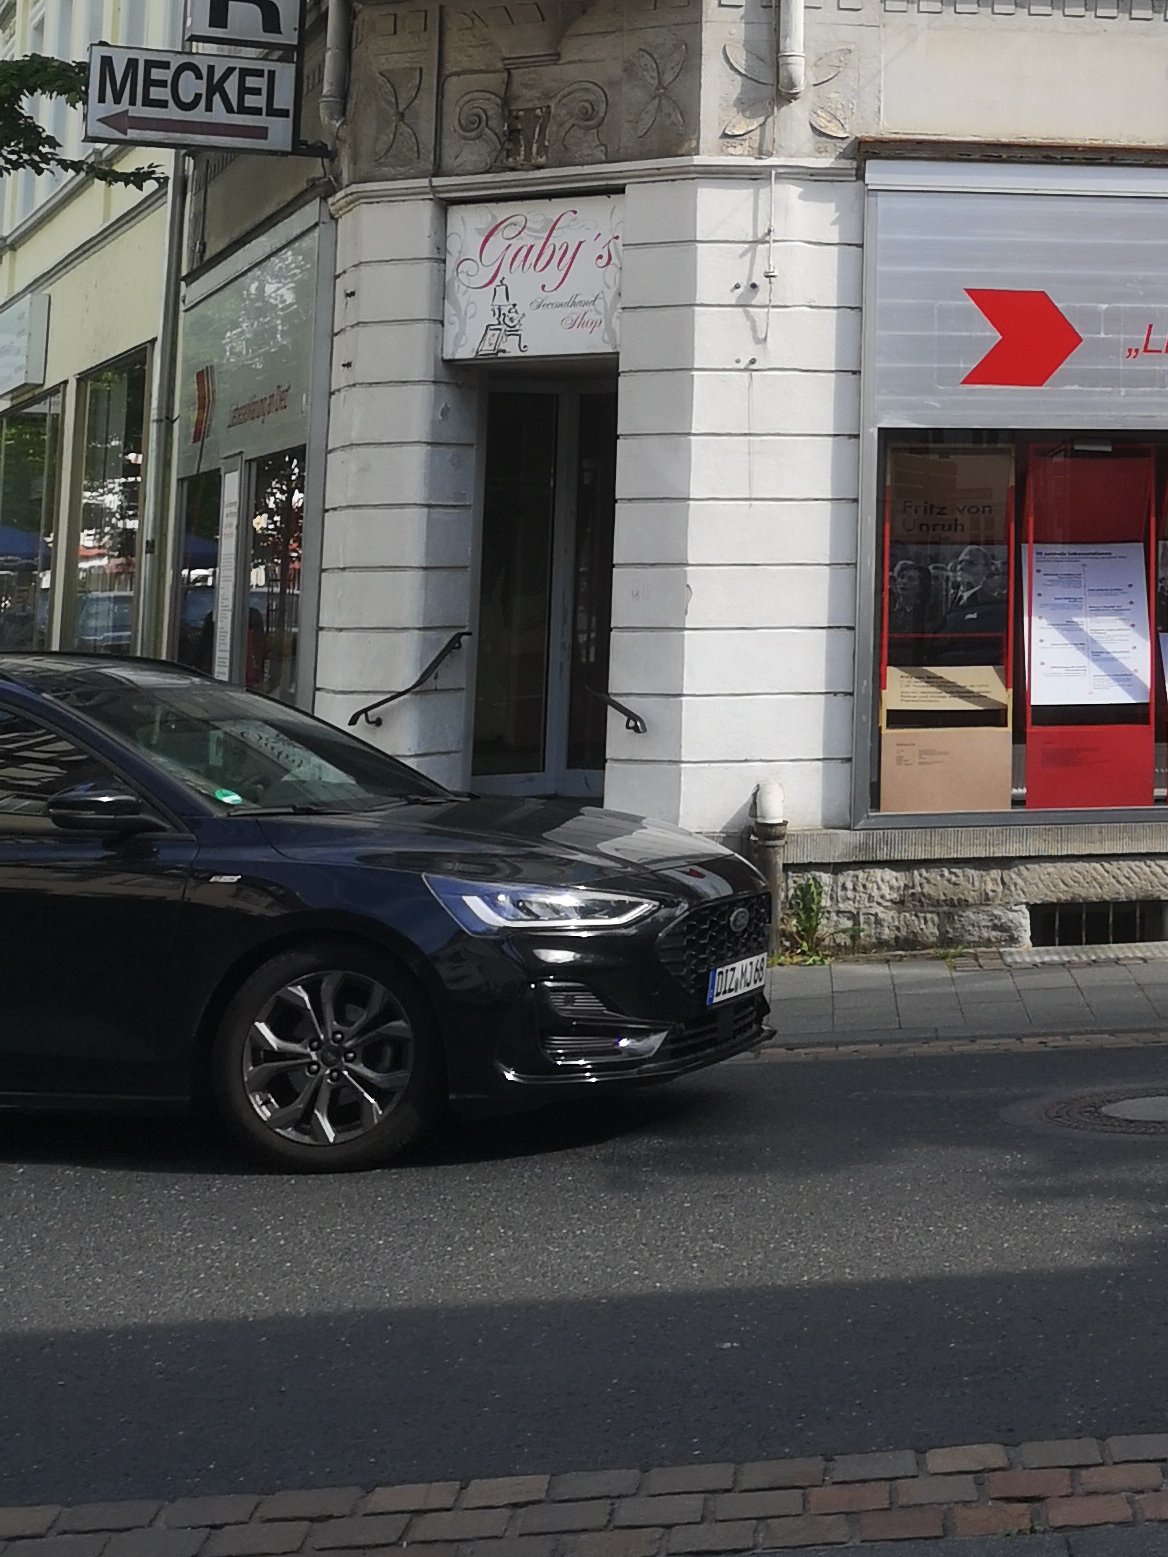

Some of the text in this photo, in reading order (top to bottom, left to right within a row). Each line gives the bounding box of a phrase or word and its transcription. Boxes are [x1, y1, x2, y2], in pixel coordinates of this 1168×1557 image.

[97, 55, 290, 118] MECKEL
[456, 209, 619, 292] Gaby's
[529, 292, 602, 311] Secondhand
[560, 310, 602, 334] Shop
[902, 500, 993, 516] Fritz von
[902, 517, 965, 532] Unruh
[715, 966, 737, 998] DIZ
